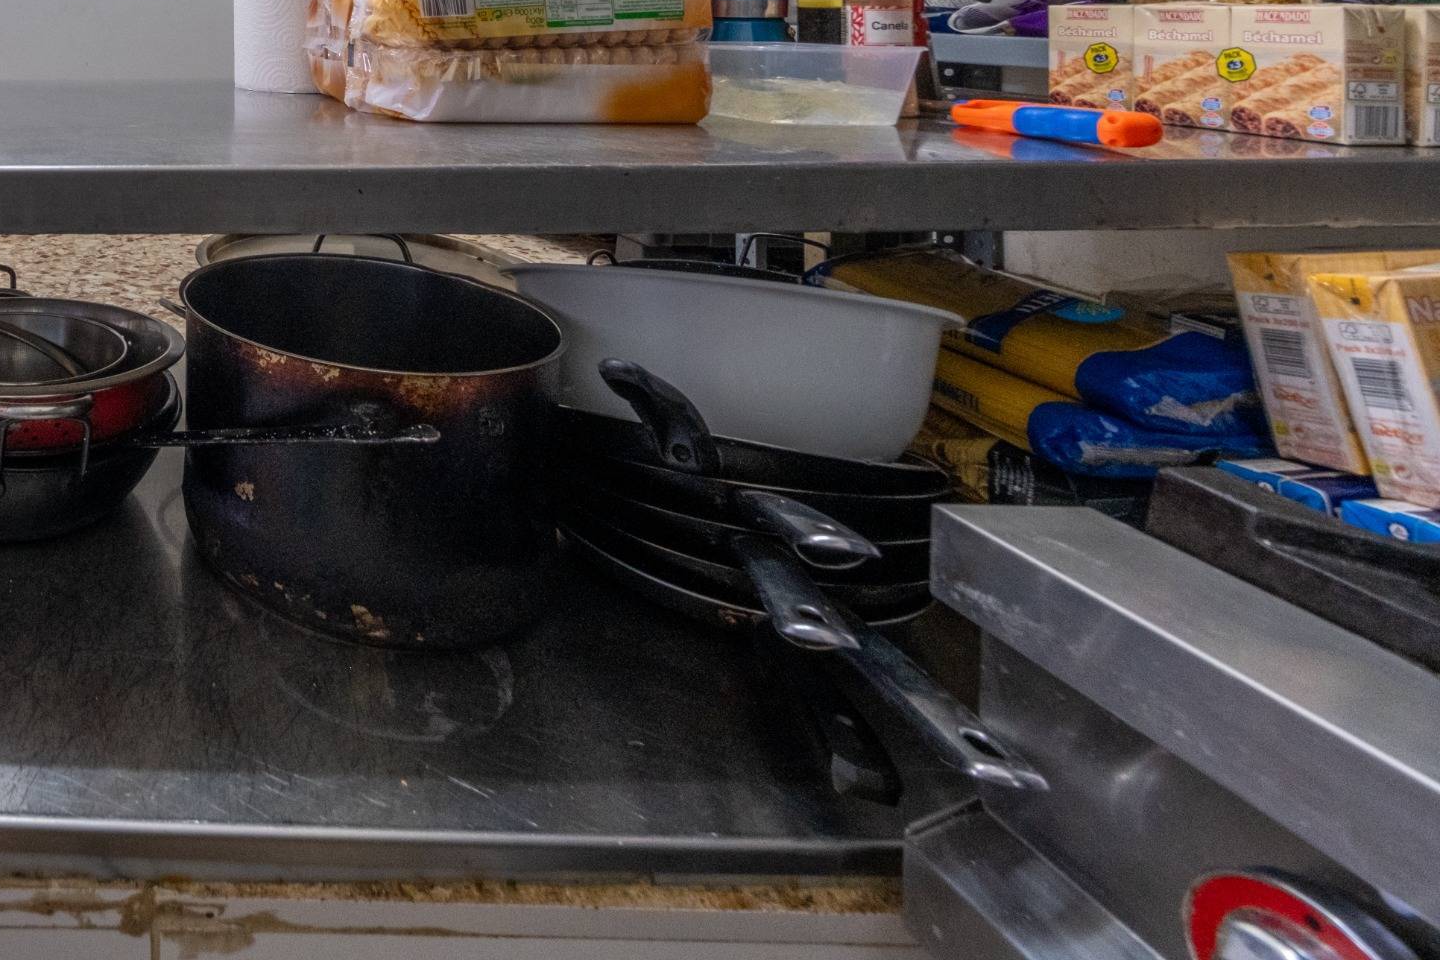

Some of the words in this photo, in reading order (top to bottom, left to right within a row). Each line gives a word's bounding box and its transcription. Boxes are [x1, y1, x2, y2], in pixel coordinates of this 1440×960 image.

[871, 21, 909, 30] Canela
[1058, 24, 1116, 38] Béchamel
[1148, 28, 1213, 41] Béchamel
[1243, 30, 1323, 44] Béchamel
